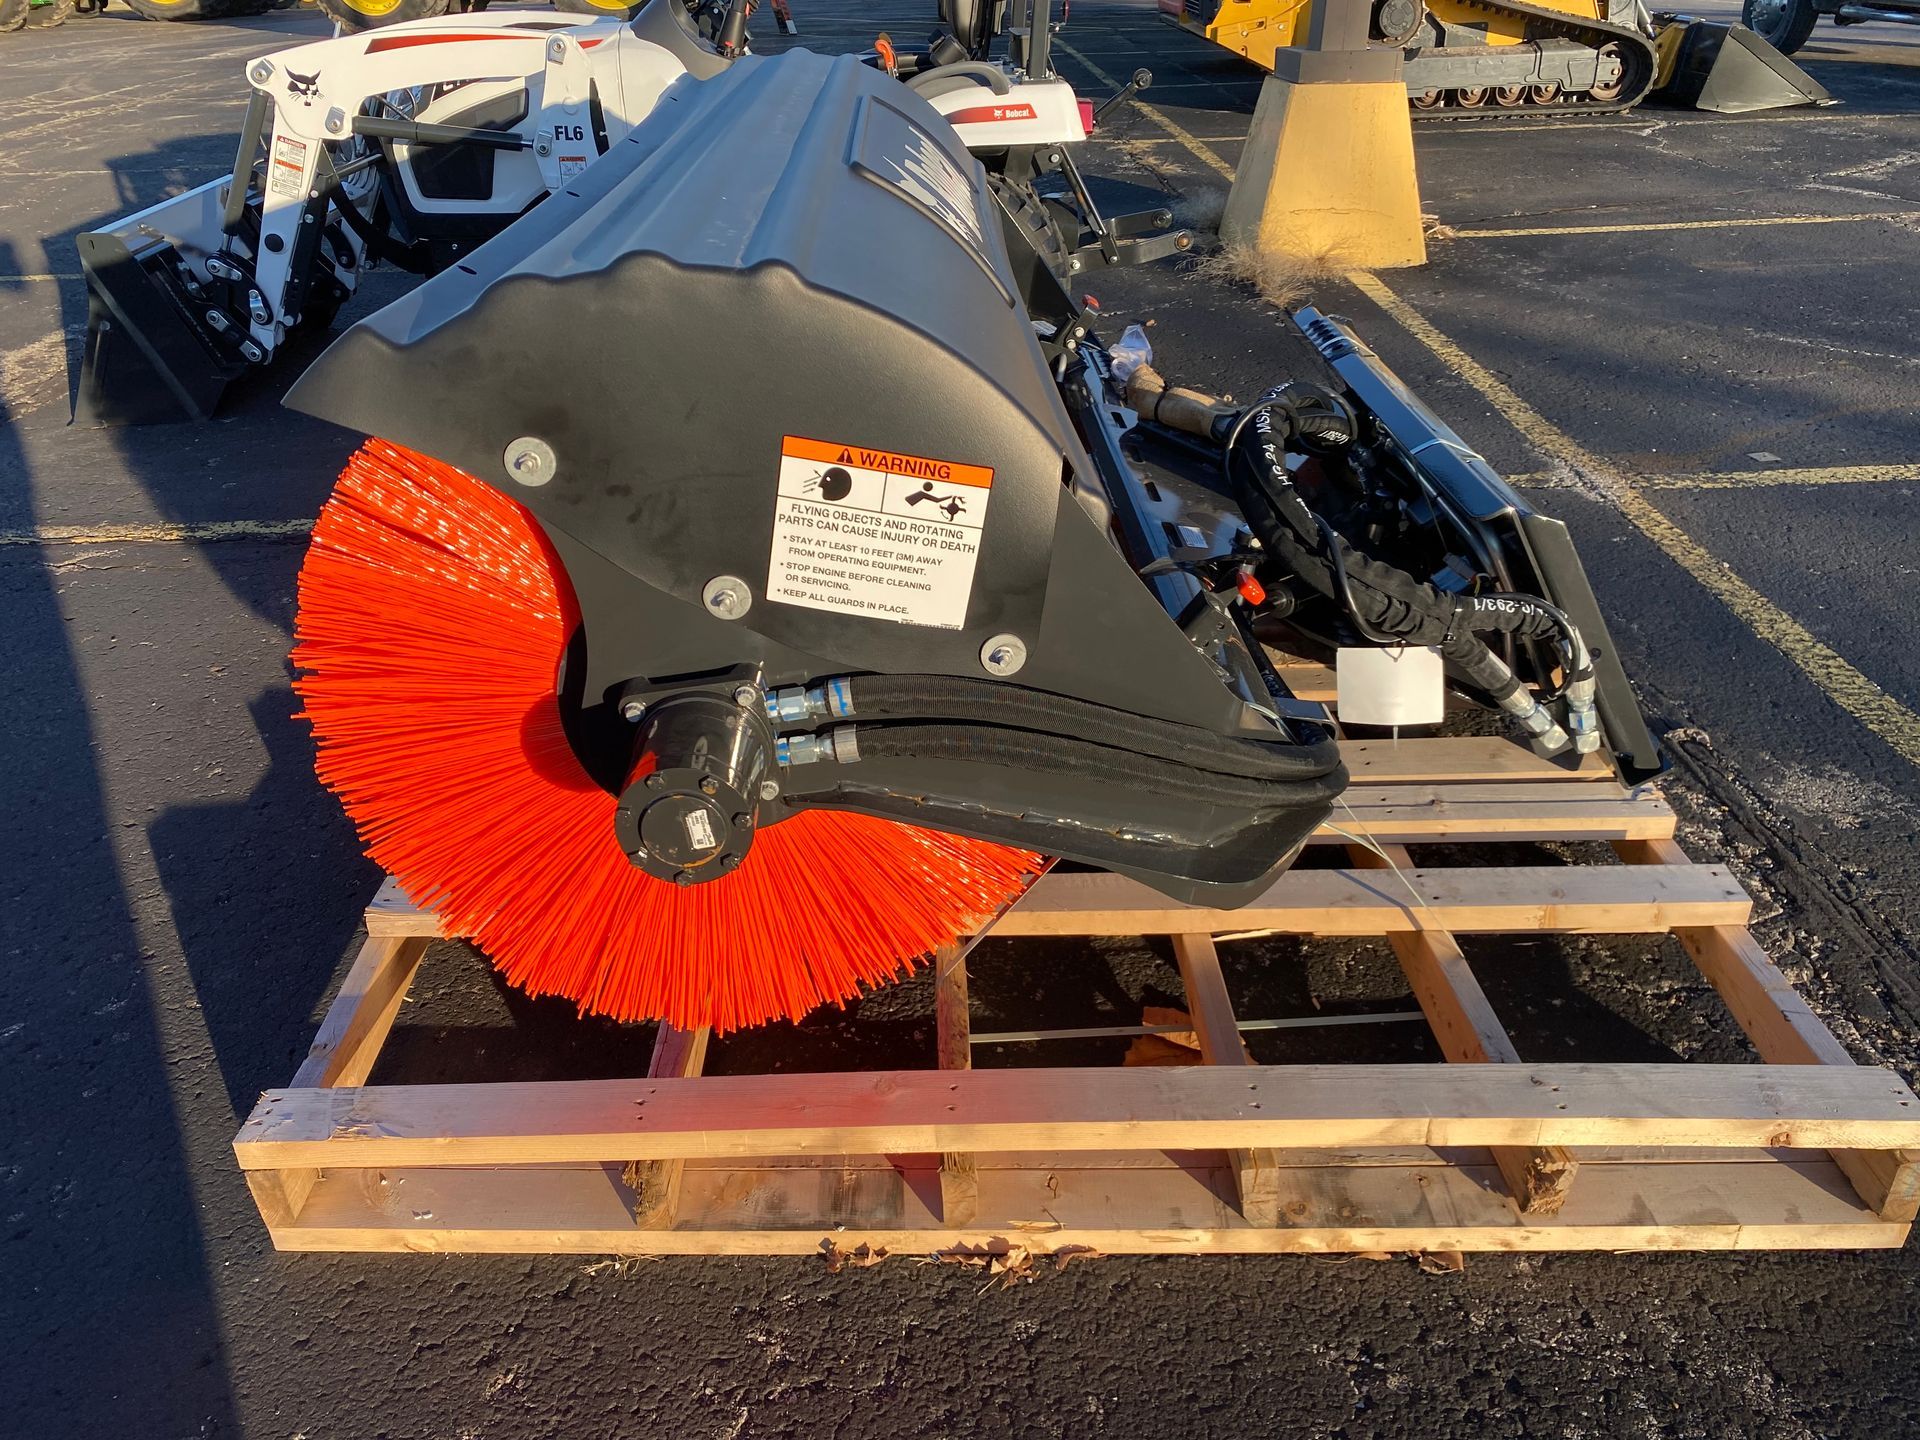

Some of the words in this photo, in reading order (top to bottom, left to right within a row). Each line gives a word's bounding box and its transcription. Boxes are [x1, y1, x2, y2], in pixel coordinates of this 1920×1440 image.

[1005, 109, 1029, 118] Bobcat
[554, 125, 584, 141] FL6
[860, 451, 950, 479] WARNING
[778, 513, 814, 527] PARTS
[816, 520, 839, 532] CAN
[842, 524, 878, 538] CAUSE
[880, 530, 920, 545] INJURY
[922, 537, 938, 548] OR
[940, 540, 976, 554] DEATH
[792, 503, 830, 518] FLYING
[832, 510, 882, 527] OBJECTS
[884, 519, 907, 531] AND
[909, 523, 964, 540] ROTATING
[788, 547, 815, 558] FROM
[817, 552, 869, 567] OPERATING
[871, 561, 927, 576] EQUIPMENT.
[789, 535, 813, 545] STAY
[814, 539, 827, 548] AT
[829, 541, 858, 553] LEAST
[860, 546, 870, 555] 10
[871, 548, 894, 559] FEET
[895, 552, 914, 563] (3M)
[916, 556, 943, 566] AWAY
[785, 573, 799, 582] OR
[800, 576, 851, 591] SERVICING.
[786, 561, 811, 572] STOP
[812, 566, 847, 578] ENGINE
[848, 572, 885, 584] BEFORE
[886, 578, 931, 591] CLEANING
[783, 588, 807, 598] KEEP
[808, 593, 825, 602] ALL
[827, 596, 865, 608] GUARDS
[866, 601, 876, 610] IN
[878, 603, 909, 614] PLACE.
